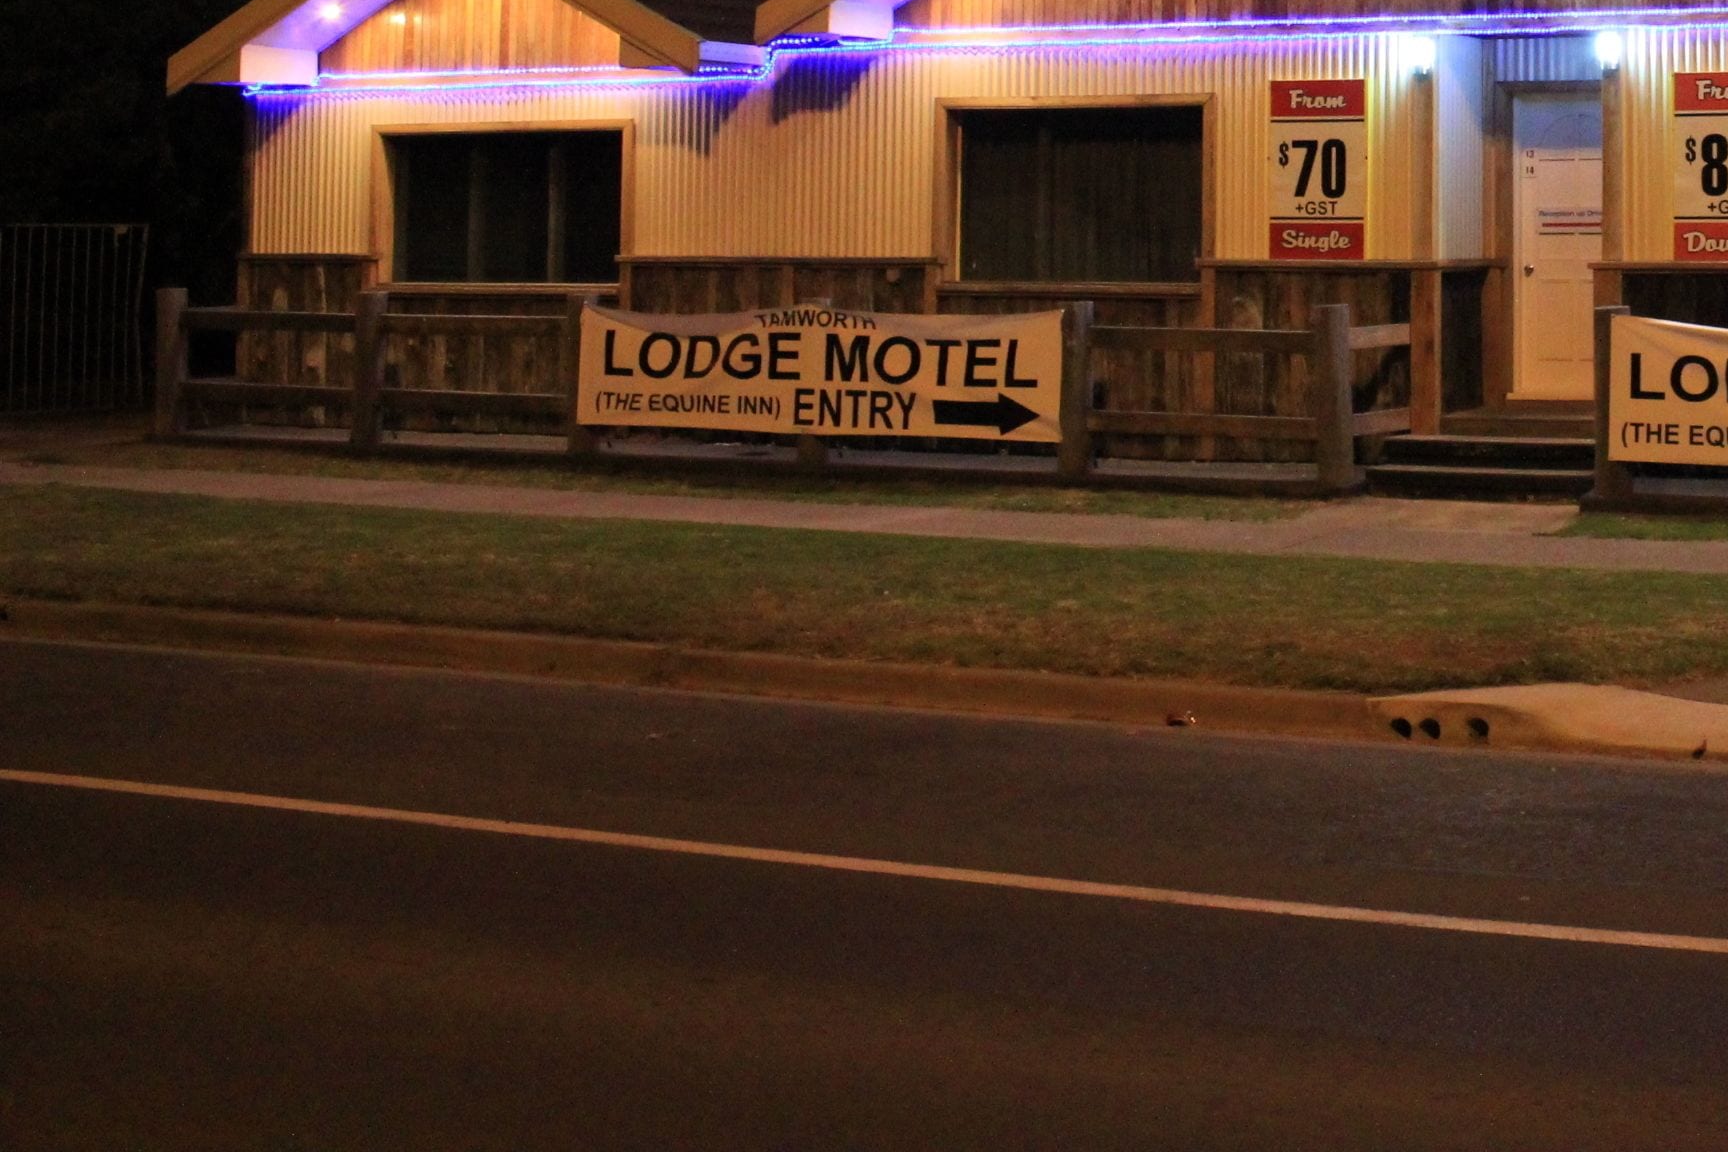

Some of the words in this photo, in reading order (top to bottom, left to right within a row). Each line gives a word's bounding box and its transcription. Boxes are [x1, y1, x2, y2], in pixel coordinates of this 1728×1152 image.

[1288, 89, 1347, 110] From
[1278, 138, 1347, 199] $70
[1295, 201, 1338, 216] +GST
[1281, 229, 1351, 253] Single
[753, 308, 878, 330] TAMWORTH
[604, 329, 801, 380] LODGE
[824, 332, 1039, 388] MOTEL
[595, 391, 643, 413] (THE
[648, 393, 730, 414] EQUINE
[737, 395, 781, 420] INN)
[793, 388, 917, 430] ENTRY
[1621, 422, 1680, 448] (THE
